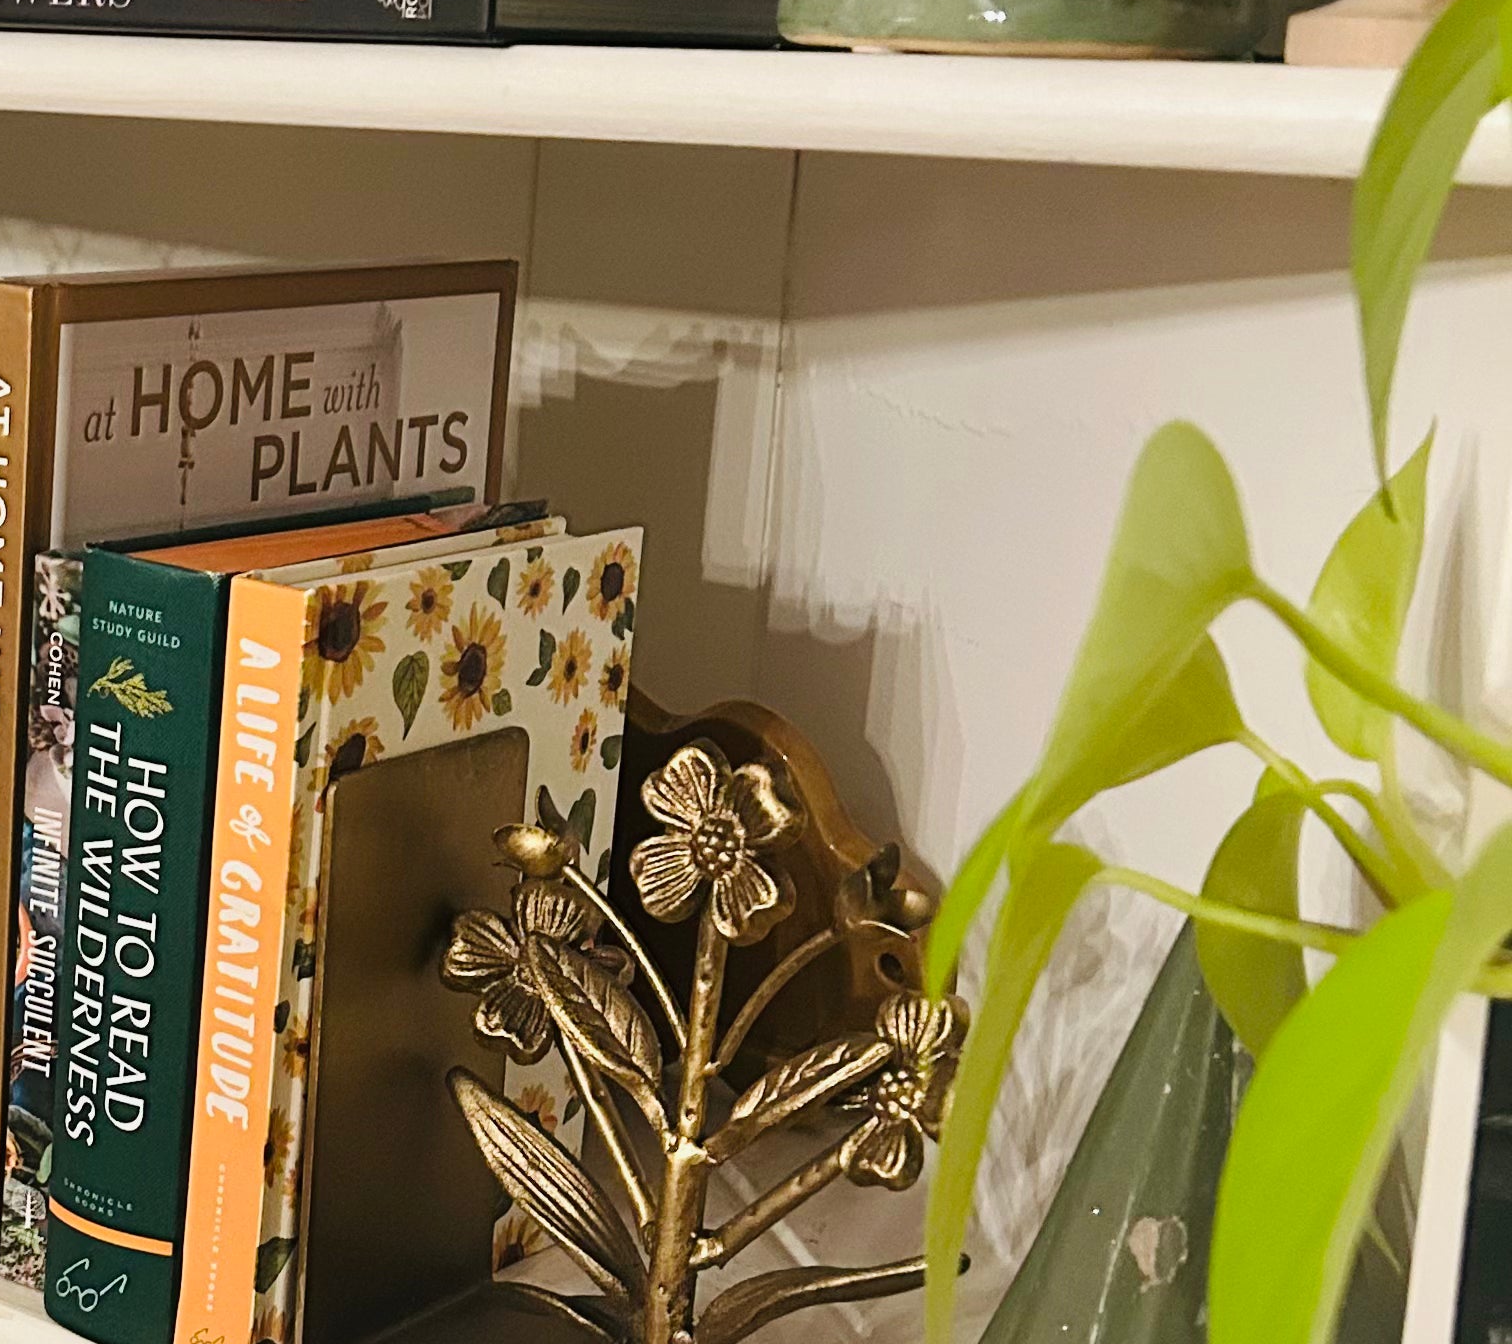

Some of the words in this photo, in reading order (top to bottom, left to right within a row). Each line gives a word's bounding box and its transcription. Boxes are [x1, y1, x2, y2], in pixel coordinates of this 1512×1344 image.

[84, 396, 116, 444] at
[130, 350, 315, 437] HOME
[323, 363, 381, 414] with
[250, 410, 469, 503] PLANTS
[92, 617, 133, 638] STUDY
[137, 629, 181, 649] GUILD
[108, 600, 163, 623] NATURE
[239, 637, 281, 669] A
[48, 631, 64, 706] COHEN
[85, 721, 122, 818] THE
[235, 684, 280, 792] LIFE
[30, 806, 63, 919] INFINITE
[120, 757, 167, 894] HOW
[229, 804, 272, 853] of
[65, 838, 114, 1147] WILDERNESS
[114, 912, 157, 979] TO
[22, 929, 57, 1079] SUCCULENT
[206, 859, 263, 1132] GRATITUDE
[104, 994, 151, 1132] READ
[75, 1196, 114, 1217] BOOKS
